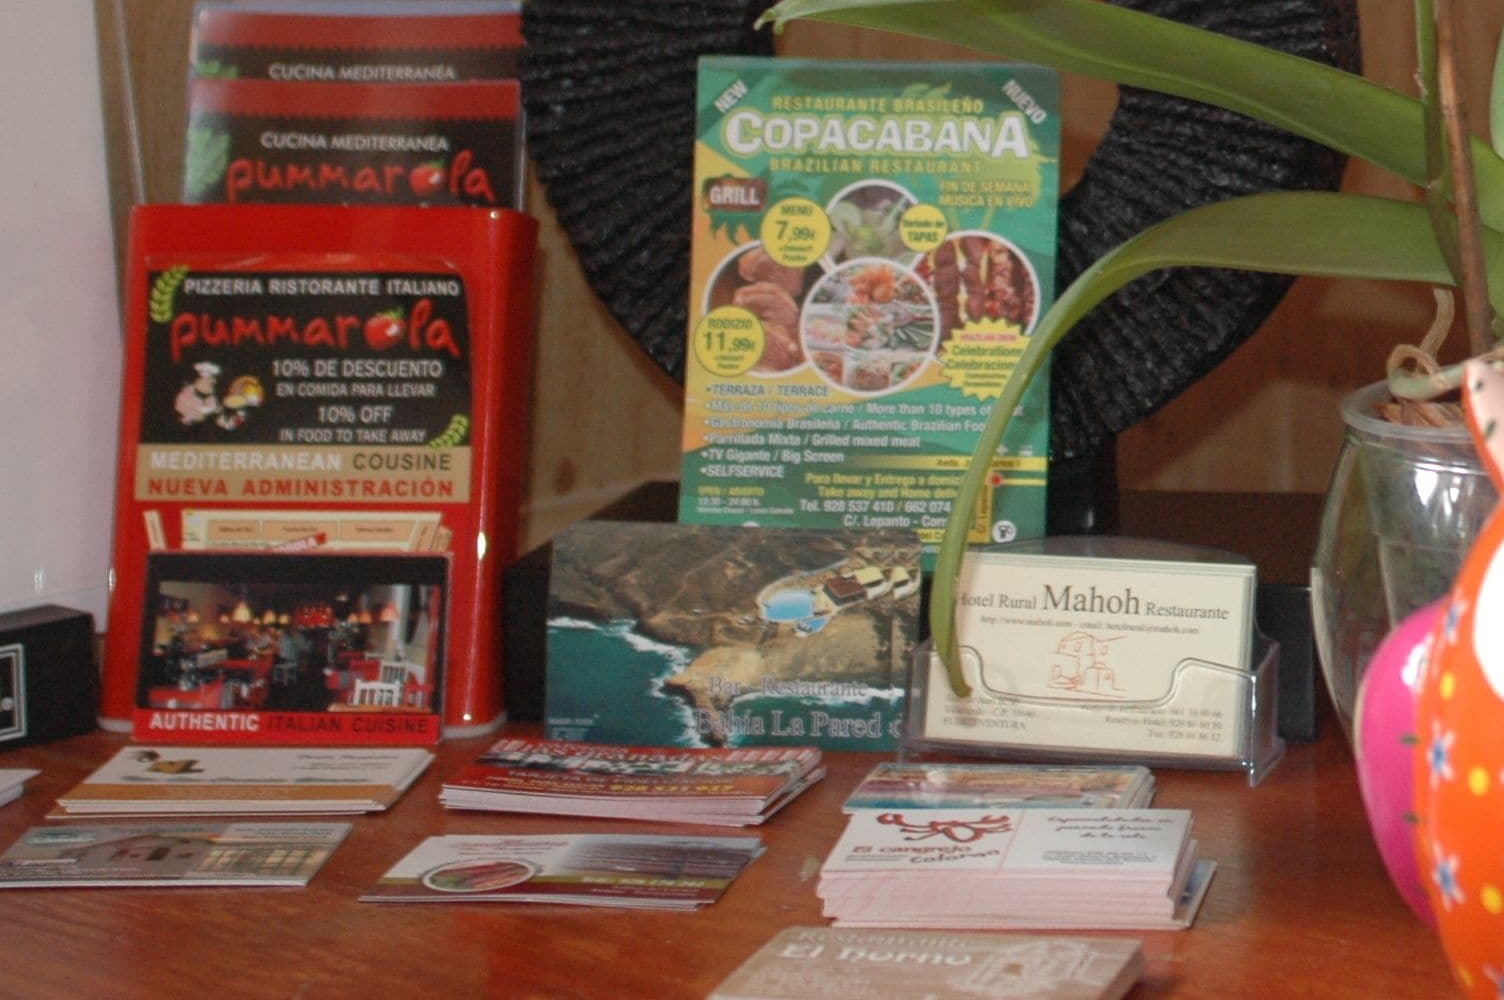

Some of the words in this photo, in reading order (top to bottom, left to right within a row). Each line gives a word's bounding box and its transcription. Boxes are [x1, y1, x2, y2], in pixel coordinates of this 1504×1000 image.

[268, 63, 335, 81] CUCINA
[339, 63, 456, 81] MEDITERRANEA
[713, 80, 748, 113] NEW
[772, 95, 886, 113] RESTAURANTE
[1002, 79, 1047, 125] NUEVO
[260, 131, 327, 151] CUCINA
[331, 132, 450, 152] MEDITERRANEA
[769, 157, 862, 174] BRAZILIAN
[869, 158, 981, 175] RESTAURANT
[710, 185, 760, 206] GRILL
[184, 278, 263, 296] PIZZERIA
[268, 278, 380, 296] RISTORANTE
[386, 278, 460, 297] ITALIANO
[272, 359, 310, 377] 10%
[315, 360, 337, 377] DE
[343, 360, 443, 378] DESCUENTO
[276, 384, 296, 397] EN
[299, 384, 347, 397] COMIDA
[351, 384, 384, 397] PARA
[387, 385, 435, 398] LLEVAR
[777, 385, 829, 398] TERRACE
[318, 405, 356, 423] 10%
[360, 406, 393, 423] OFF
[280, 428, 295, 442] IN
[298, 429, 333, 442] FOOD
[336, 429, 354, 442] TO
[356, 429, 388, 442] TAKE
[390, 430, 427, 443] AWAY
[150, 451, 344, 471] MEDITERRANEAN
[352, 452, 453, 472] COUSINE
[147, 478, 229, 497] NUEVA
[242, 476, 454, 498] ADMINISTRACIÓN
[999, 594, 1037, 611] Rural
[1042, 584, 1141, 615] Mahoh
[1145, 602, 1230, 621] Restaurante
[709, 674, 742, 697] Bar
[761, 675, 869, 699] Restaurante
[149, 714, 261, 733] AUTHENTIC
[266, 715, 343, 734] ITALIAN
[351, 716, 430, 735] CUISINE
[770, 709, 805, 737] La
[809, 711, 883, 738] Pared
